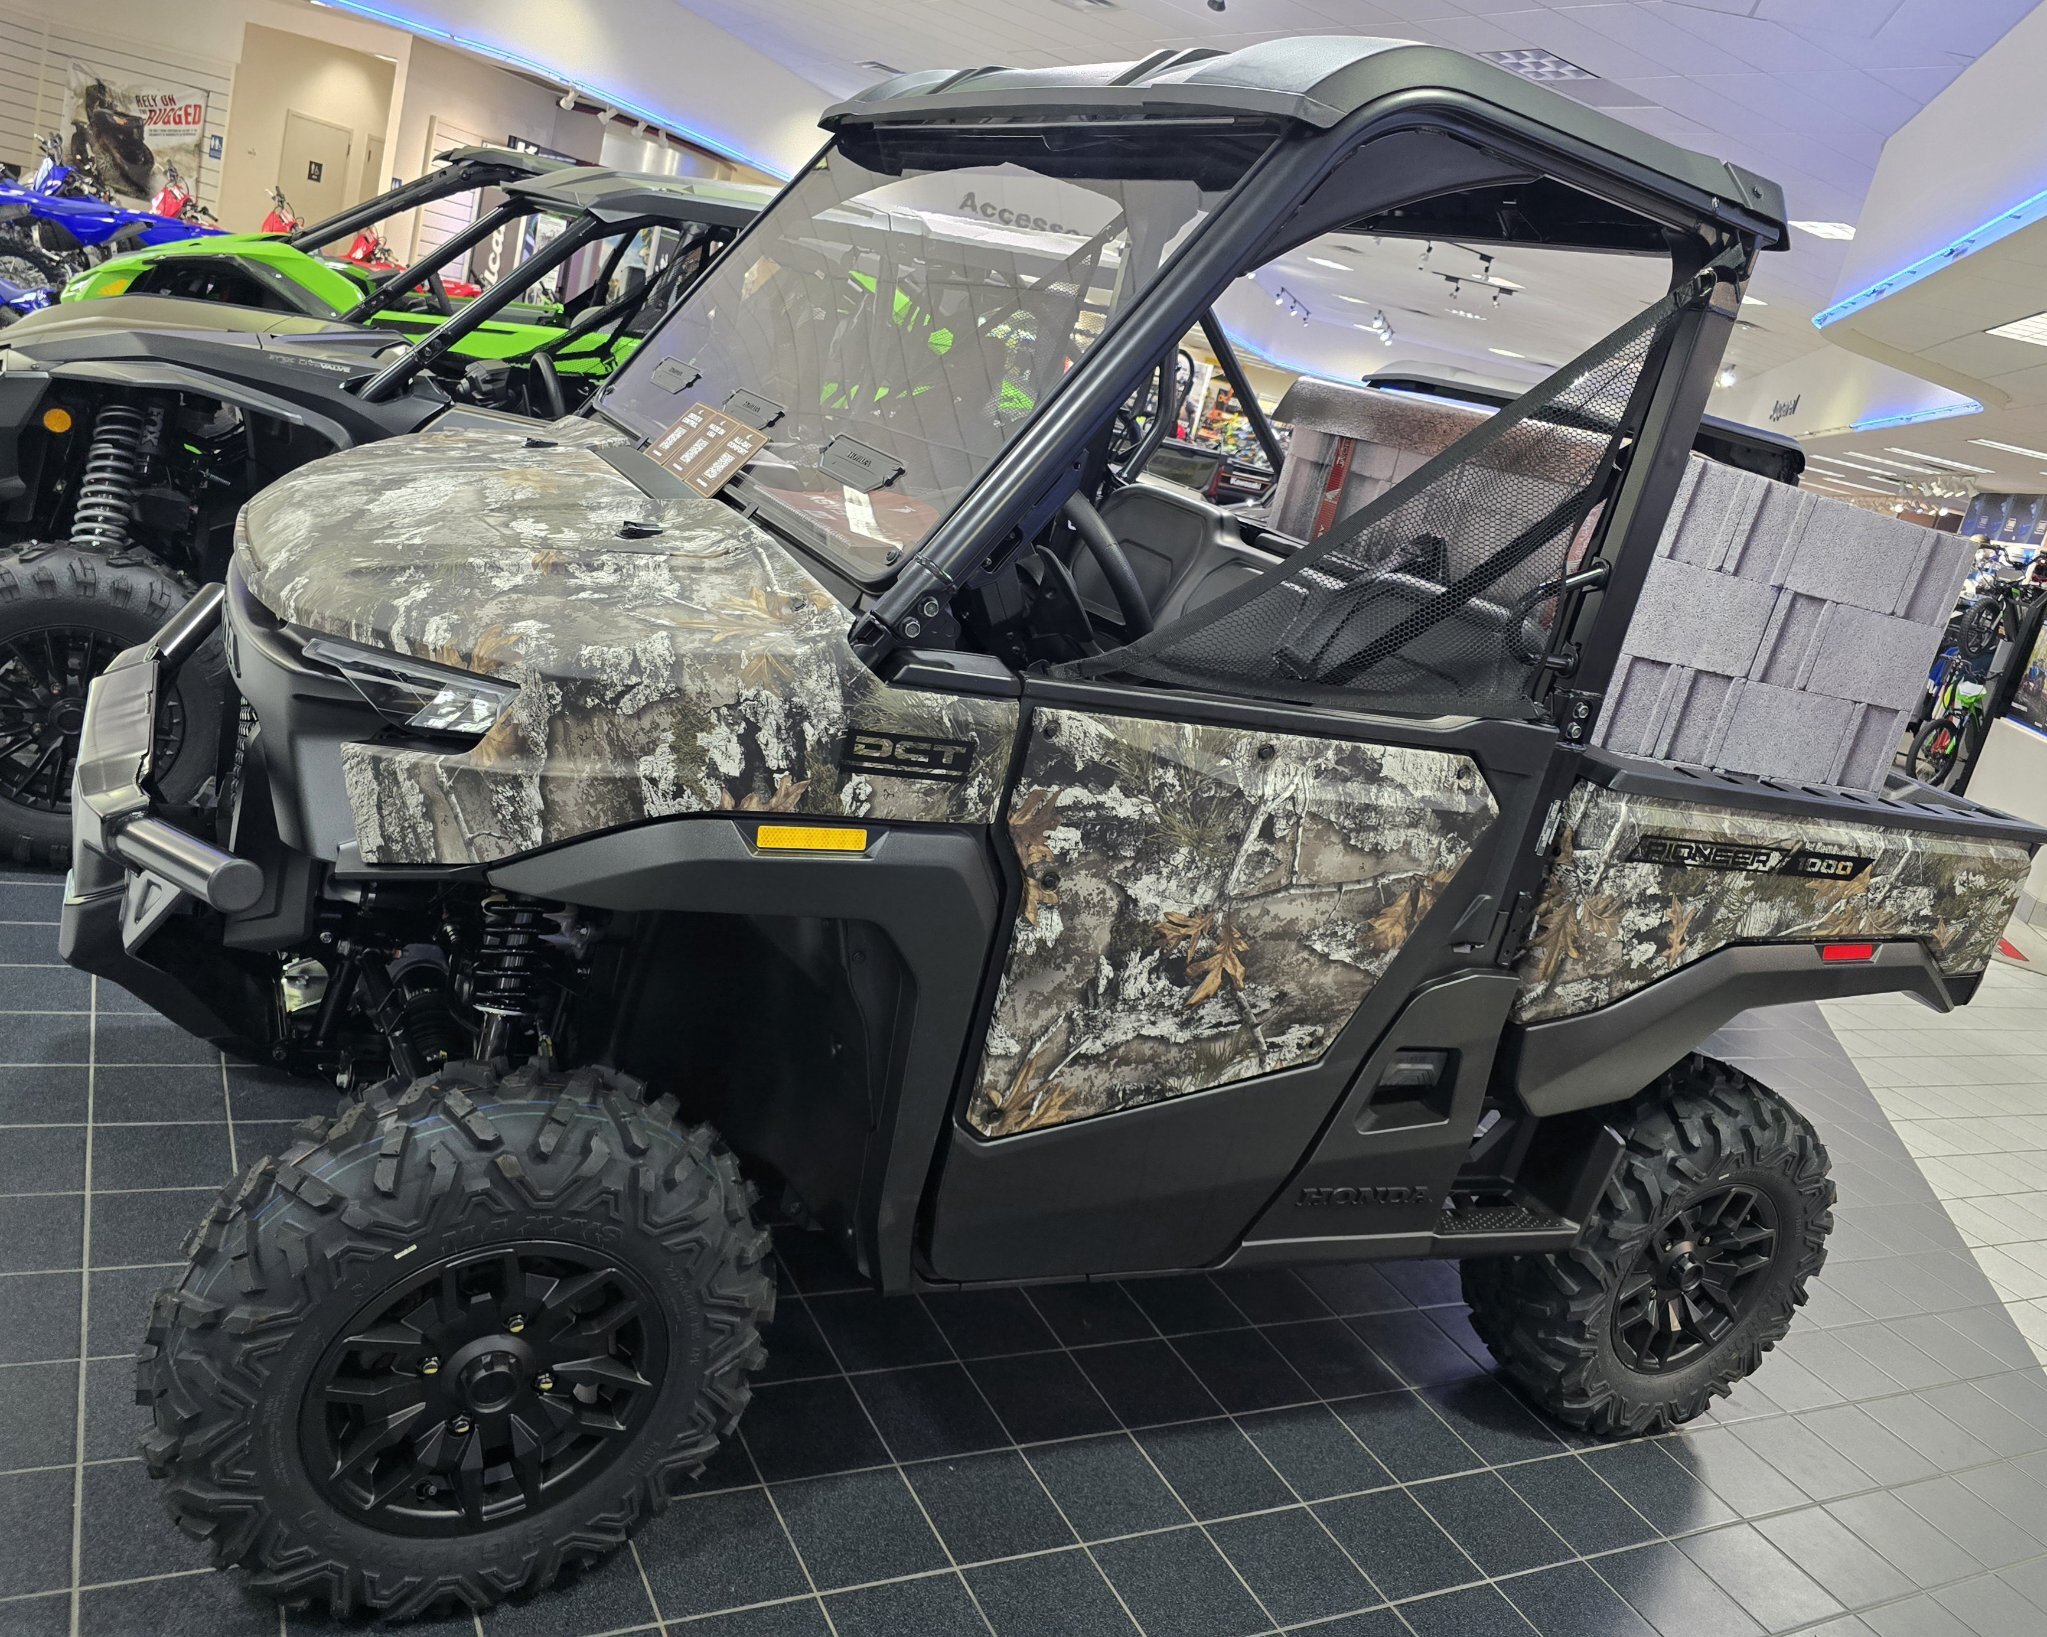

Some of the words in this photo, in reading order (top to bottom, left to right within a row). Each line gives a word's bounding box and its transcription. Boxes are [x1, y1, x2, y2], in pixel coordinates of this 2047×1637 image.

[135, 94, 158, 108] RELY
[160, 94, 177, 107] ON
[143, 104, 202, 126] RUGGED
[141, 406, 165, 446] FOX
[853, 735, 967, 764] DCT
[1643, 840, 1775, 870] PIONEER
[1797, 856, 1854, 876] 1000
[1296, 1186, 1433, 1206] HONDA
